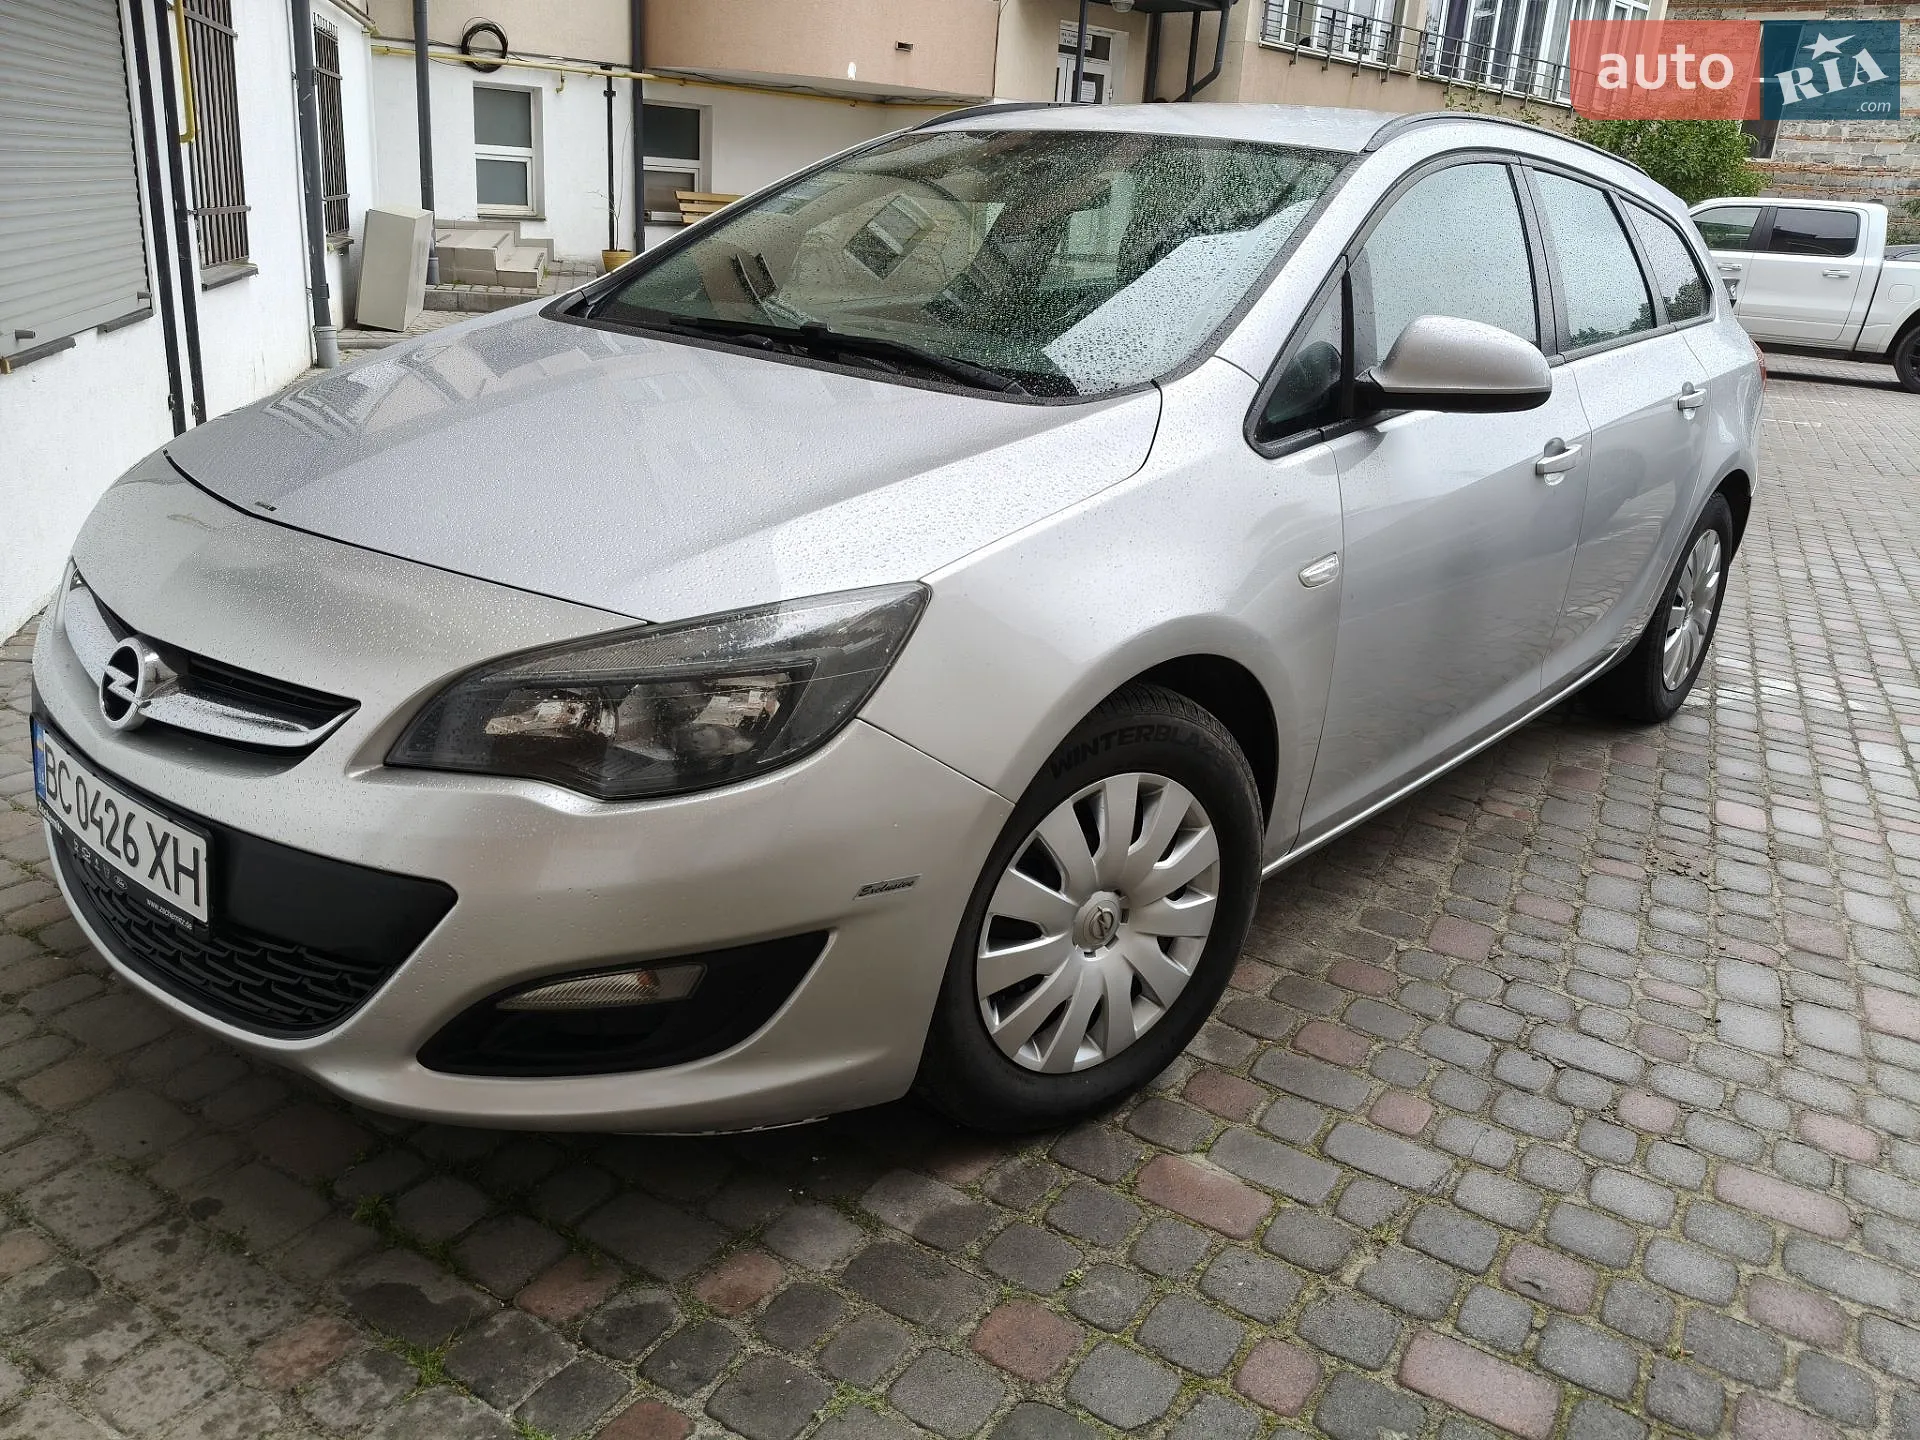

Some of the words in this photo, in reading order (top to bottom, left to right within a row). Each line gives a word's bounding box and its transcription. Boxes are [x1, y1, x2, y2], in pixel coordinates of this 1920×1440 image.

[44, 742, 72, 815] BC
[75, 775, 140, 868] 0426
[146, 820, 201, 908] XH
